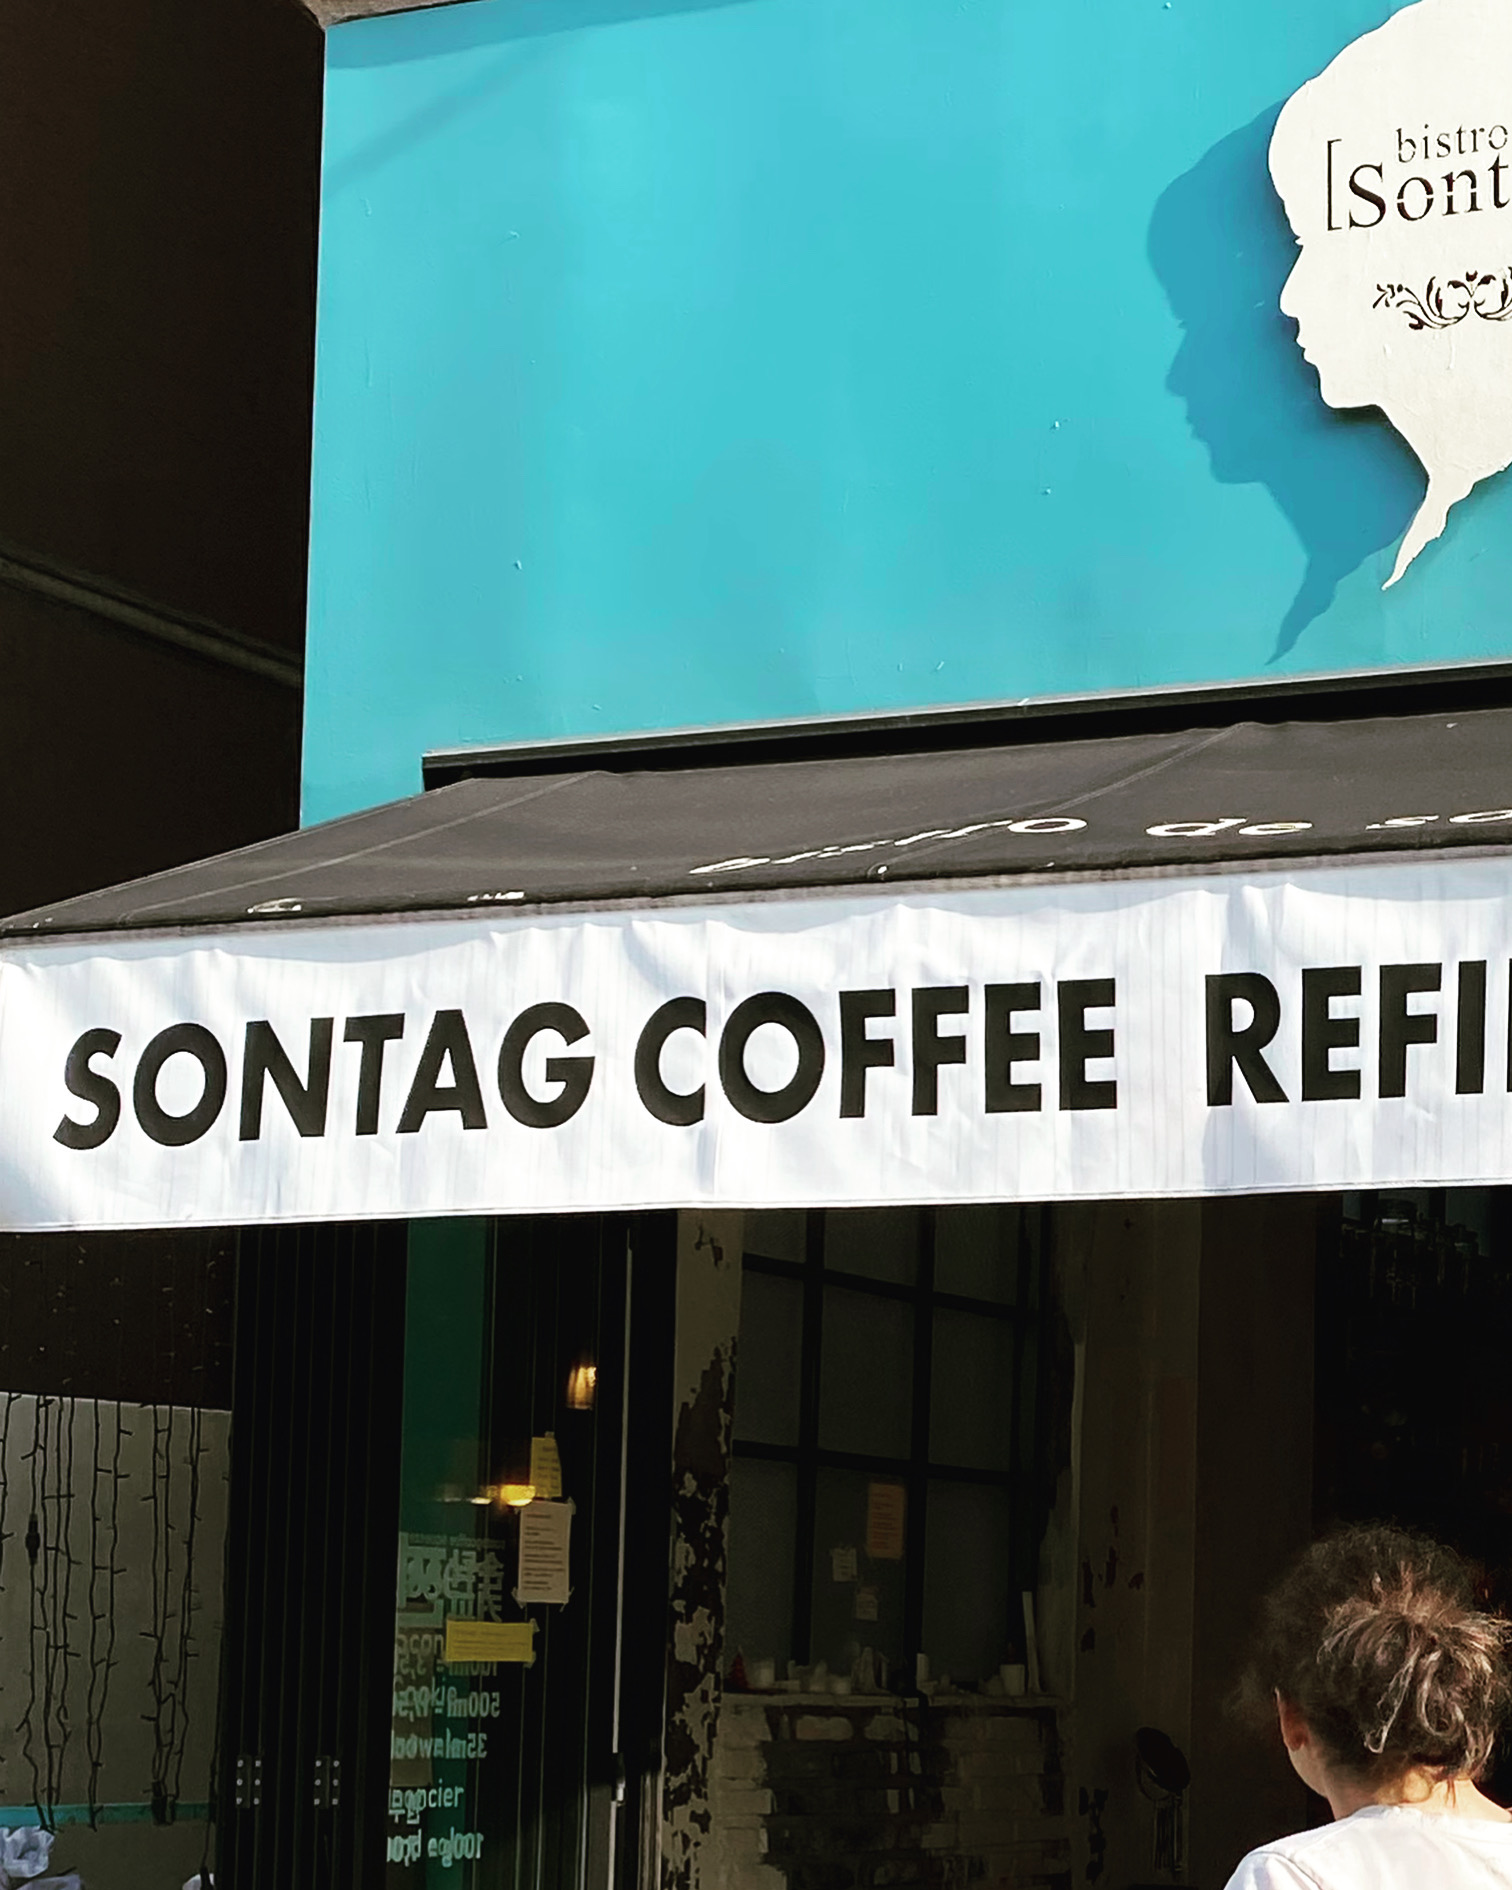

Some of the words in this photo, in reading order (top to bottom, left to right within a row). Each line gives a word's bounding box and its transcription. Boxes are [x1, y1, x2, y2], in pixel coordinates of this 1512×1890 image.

[1395, 121, 1509, 163] bistro
[52, 1002, 595, 1151] SONTAG
[634, 977, 1118, 1127] COFFEE
